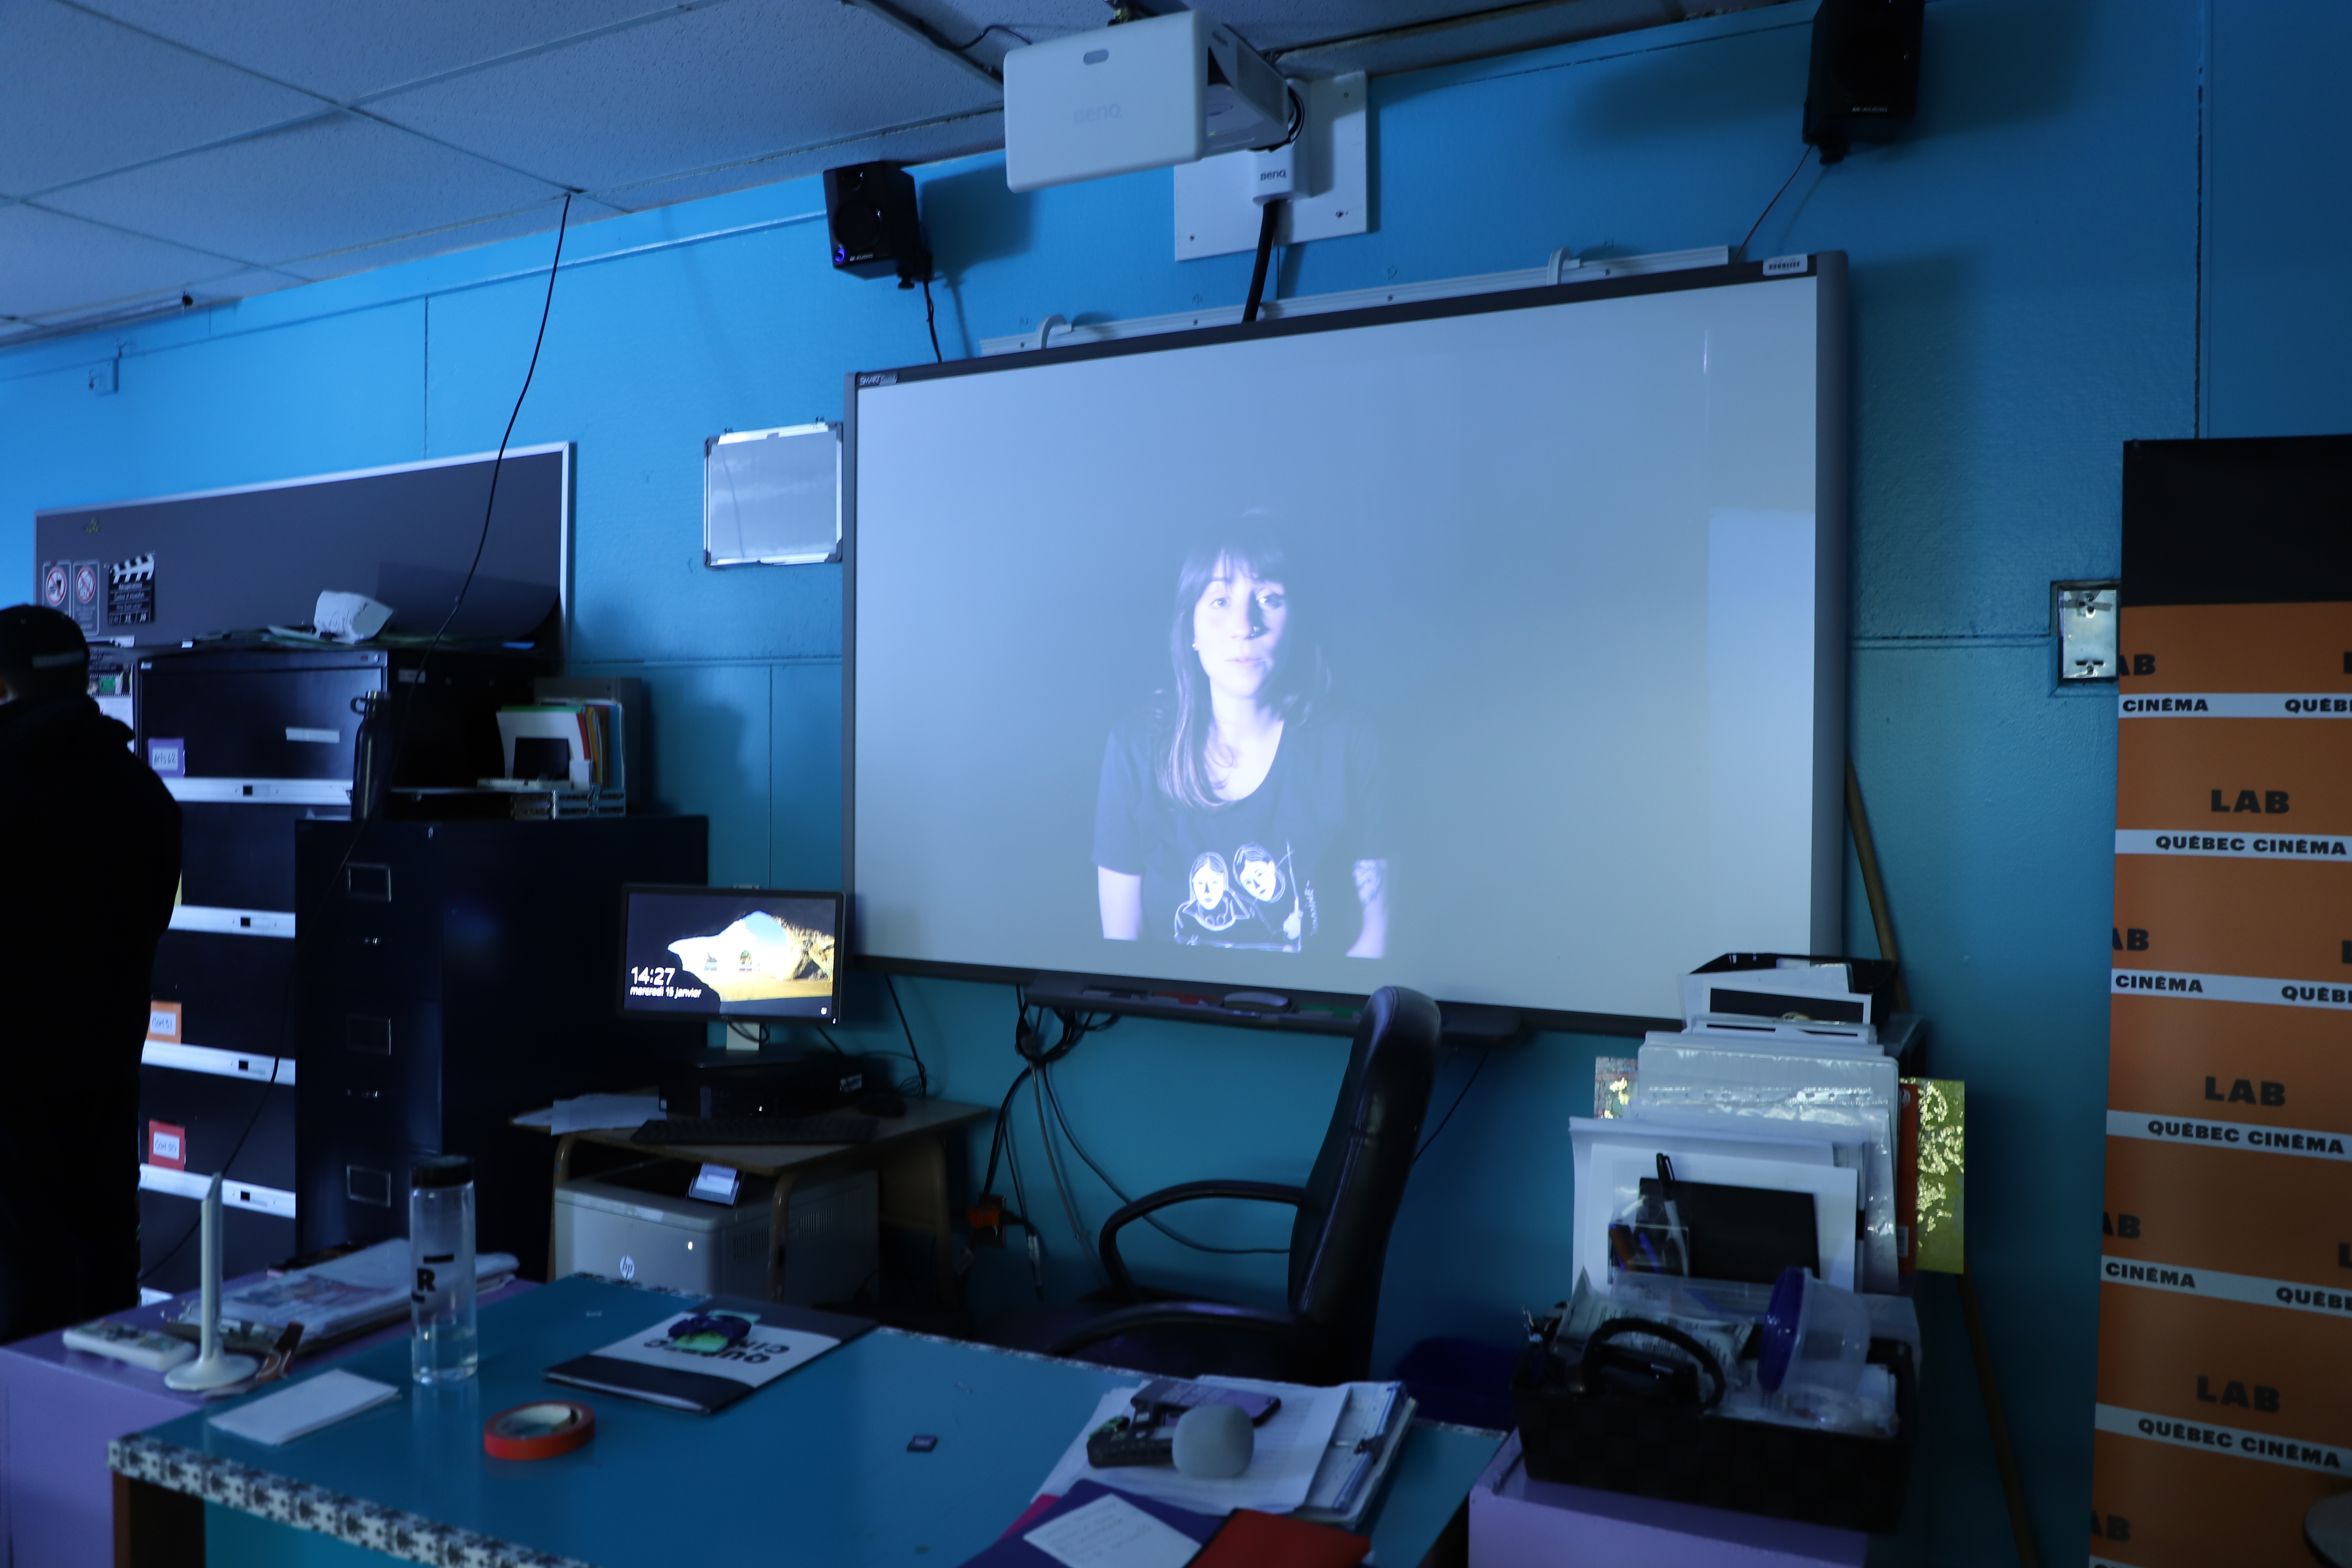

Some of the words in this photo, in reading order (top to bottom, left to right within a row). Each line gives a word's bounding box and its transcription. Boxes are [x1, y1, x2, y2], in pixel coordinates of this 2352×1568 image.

[1260, 170, 1288, 181] BenQ
[860, 375, 881, 385] SMART
[2122, 698, 2208, 712] CINÉMA
[2285, 698, 2352, 714] QUÉB
[2211, 789, 2290, 814] LAB
[2156, 836, 2245, 851] QUÉBEC
[2253, 839, 2346, 855] CINÉMA
[631, 966, 675, 985] 14:27
[2115, 975, 2203, 993] CINÉMA
[630, 986, 664, 997] mercredi
[666, 986, 674, 997] 15
[674, 987, 702, 999] janvier
[2205, 1076, 2286, 1107] LAB
[2148, 1121, 2240, 1142] QUÉBEC
[2248, 1131, 2344, 1154] CINÉMA
[2105, 1262, 2195, 1288] CINÉMA
[2197, 1376, 2280, 1413] LAB
[2138, 1418, 2233, 1448] QUÉBEC
[2241, 1437, 2341, 1468] CINÉMA
